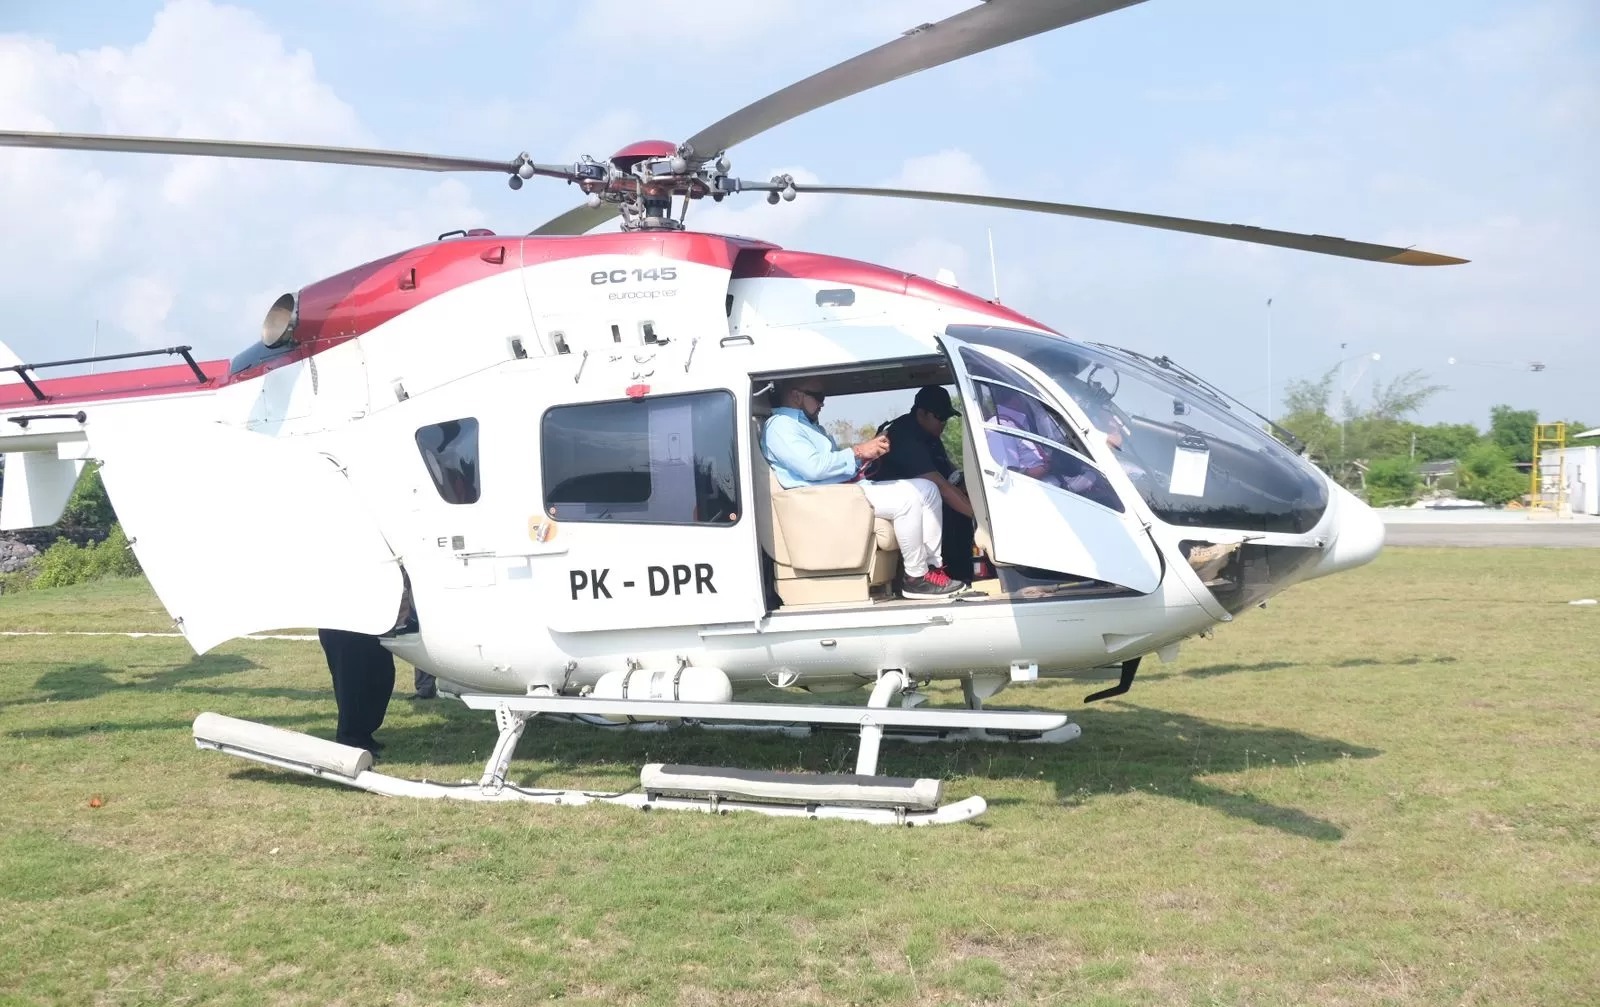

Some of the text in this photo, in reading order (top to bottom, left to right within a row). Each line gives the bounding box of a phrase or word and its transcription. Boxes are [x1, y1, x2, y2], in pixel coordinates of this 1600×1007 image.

[631, 267, 678, 281] 145
[569, 568, 613, 600] PK
[647, 563, 718, 597] DPR
